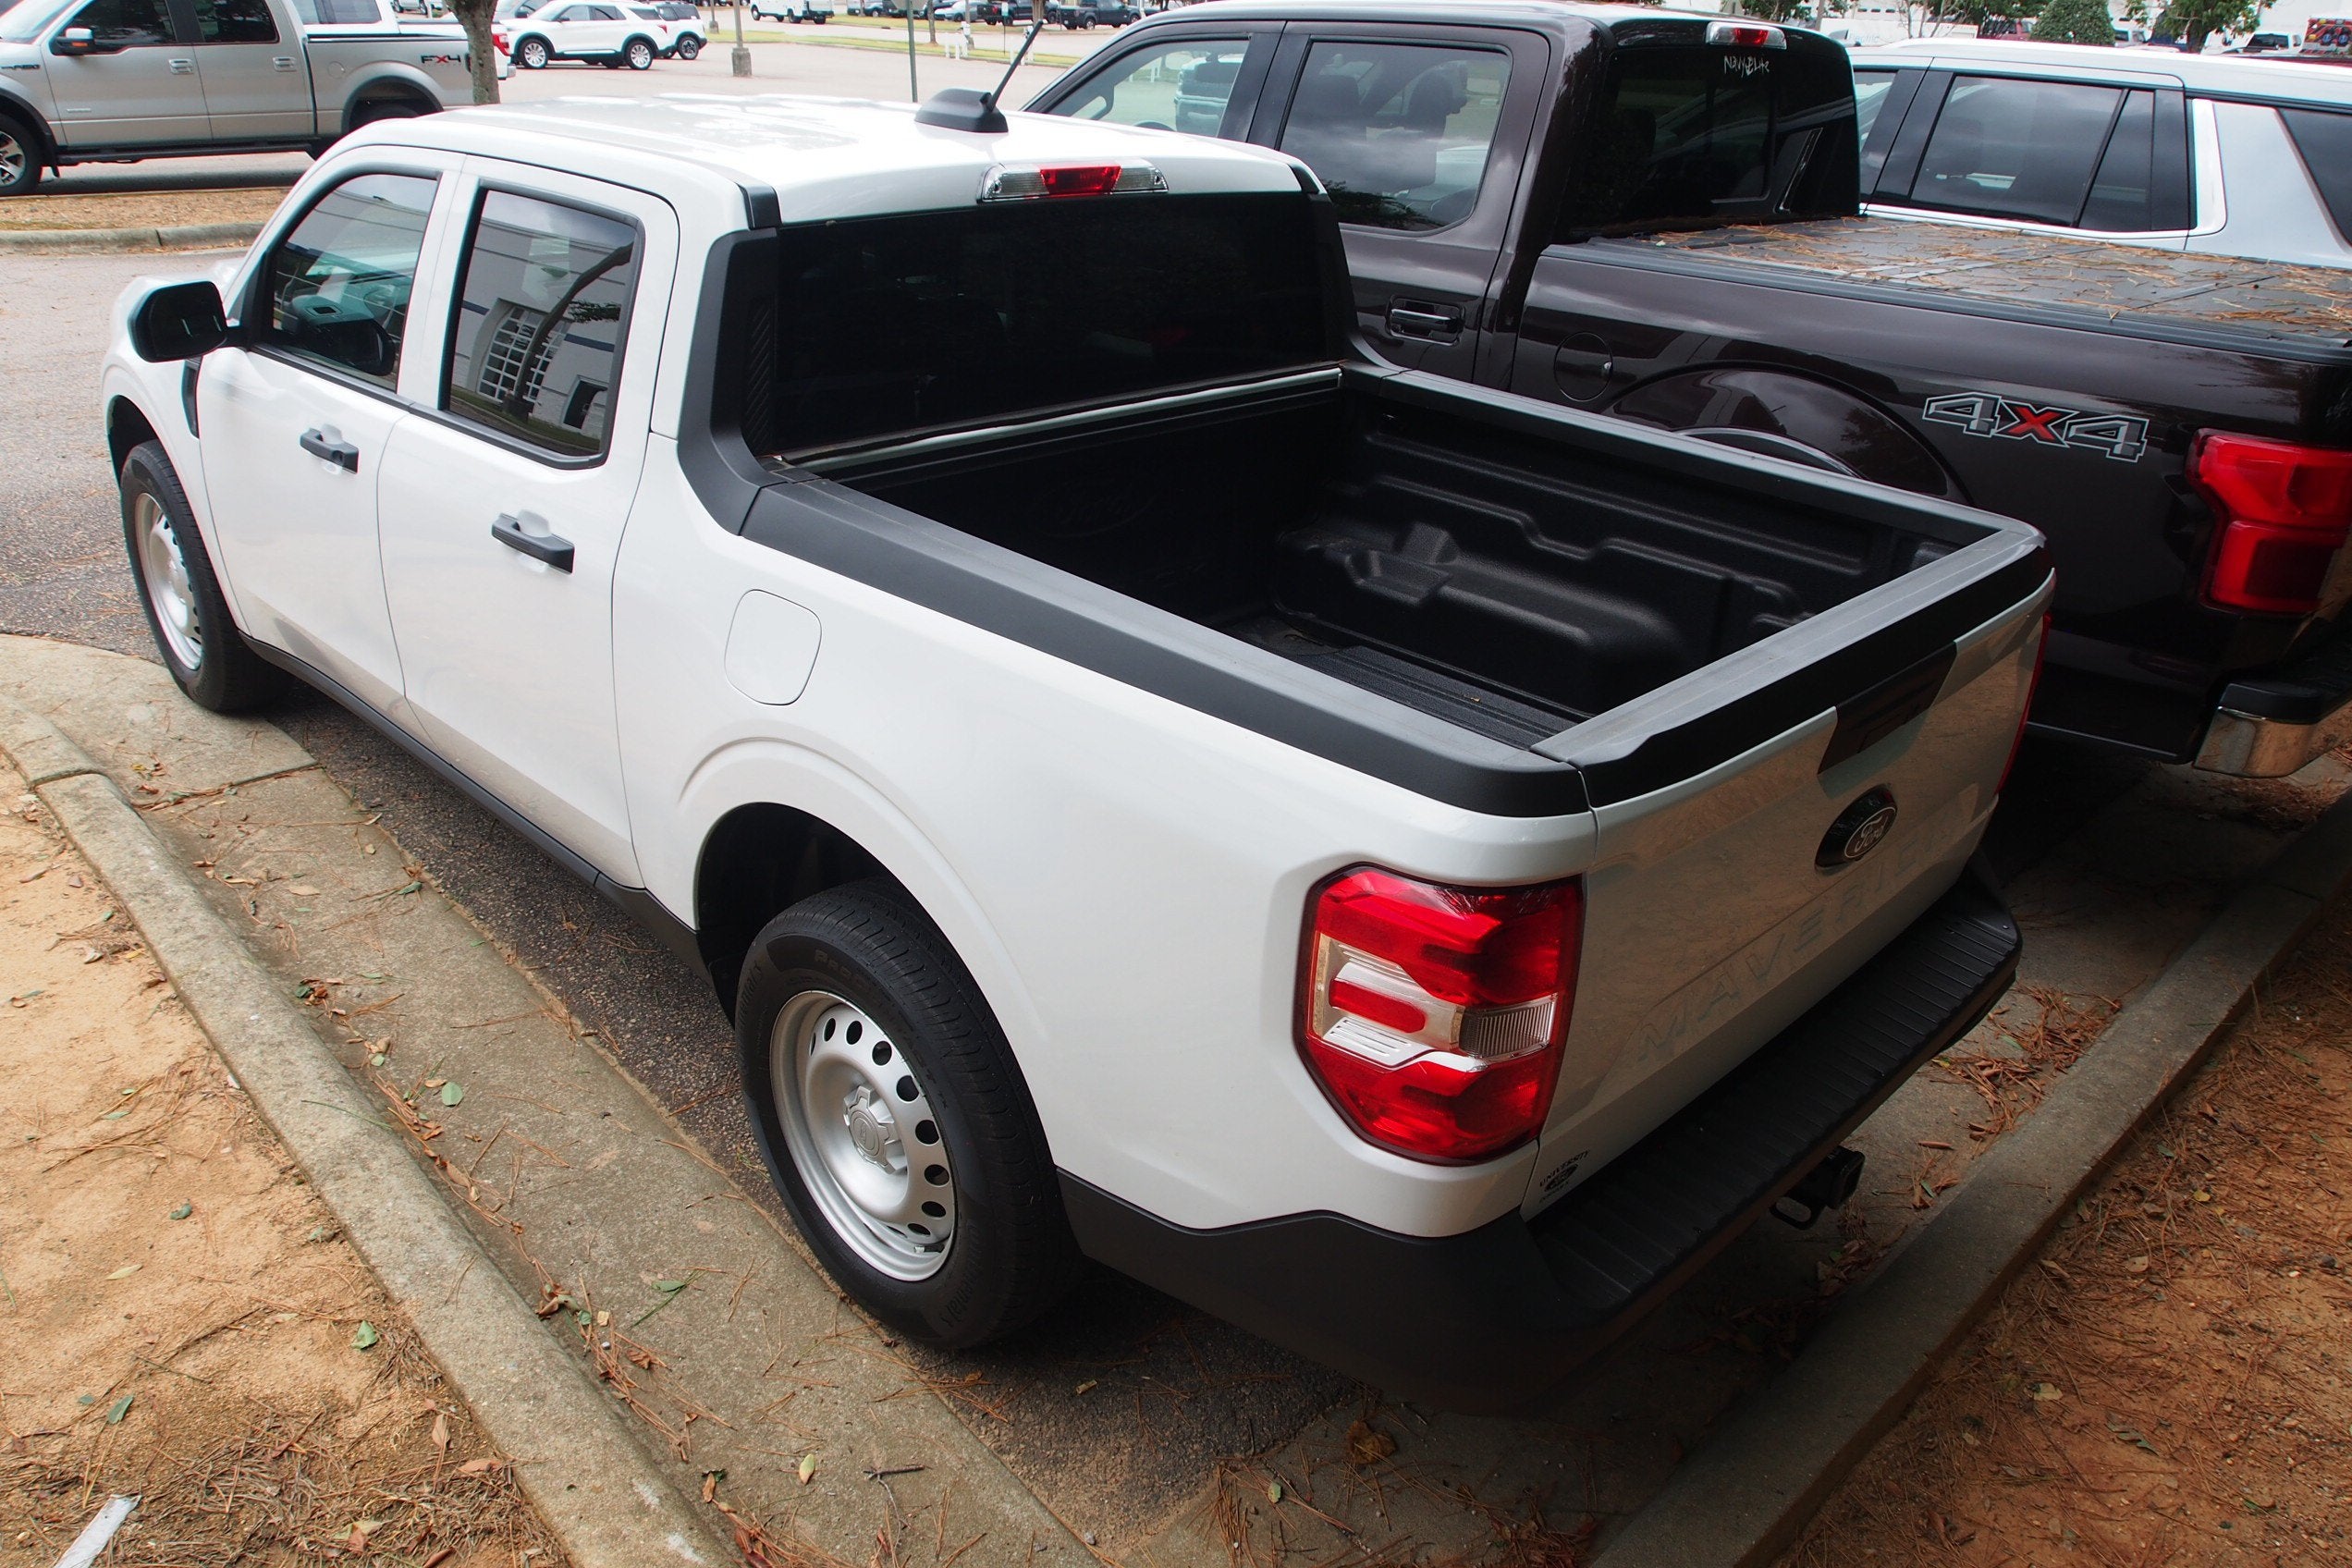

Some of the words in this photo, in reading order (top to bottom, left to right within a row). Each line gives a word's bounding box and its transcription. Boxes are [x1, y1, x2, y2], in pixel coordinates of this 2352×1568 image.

[421, 55, 461, 64] FX4
[1852, 813, 1891, 854] Ford
[1539, 1148, 1590, 1188] UNIVERSITY
